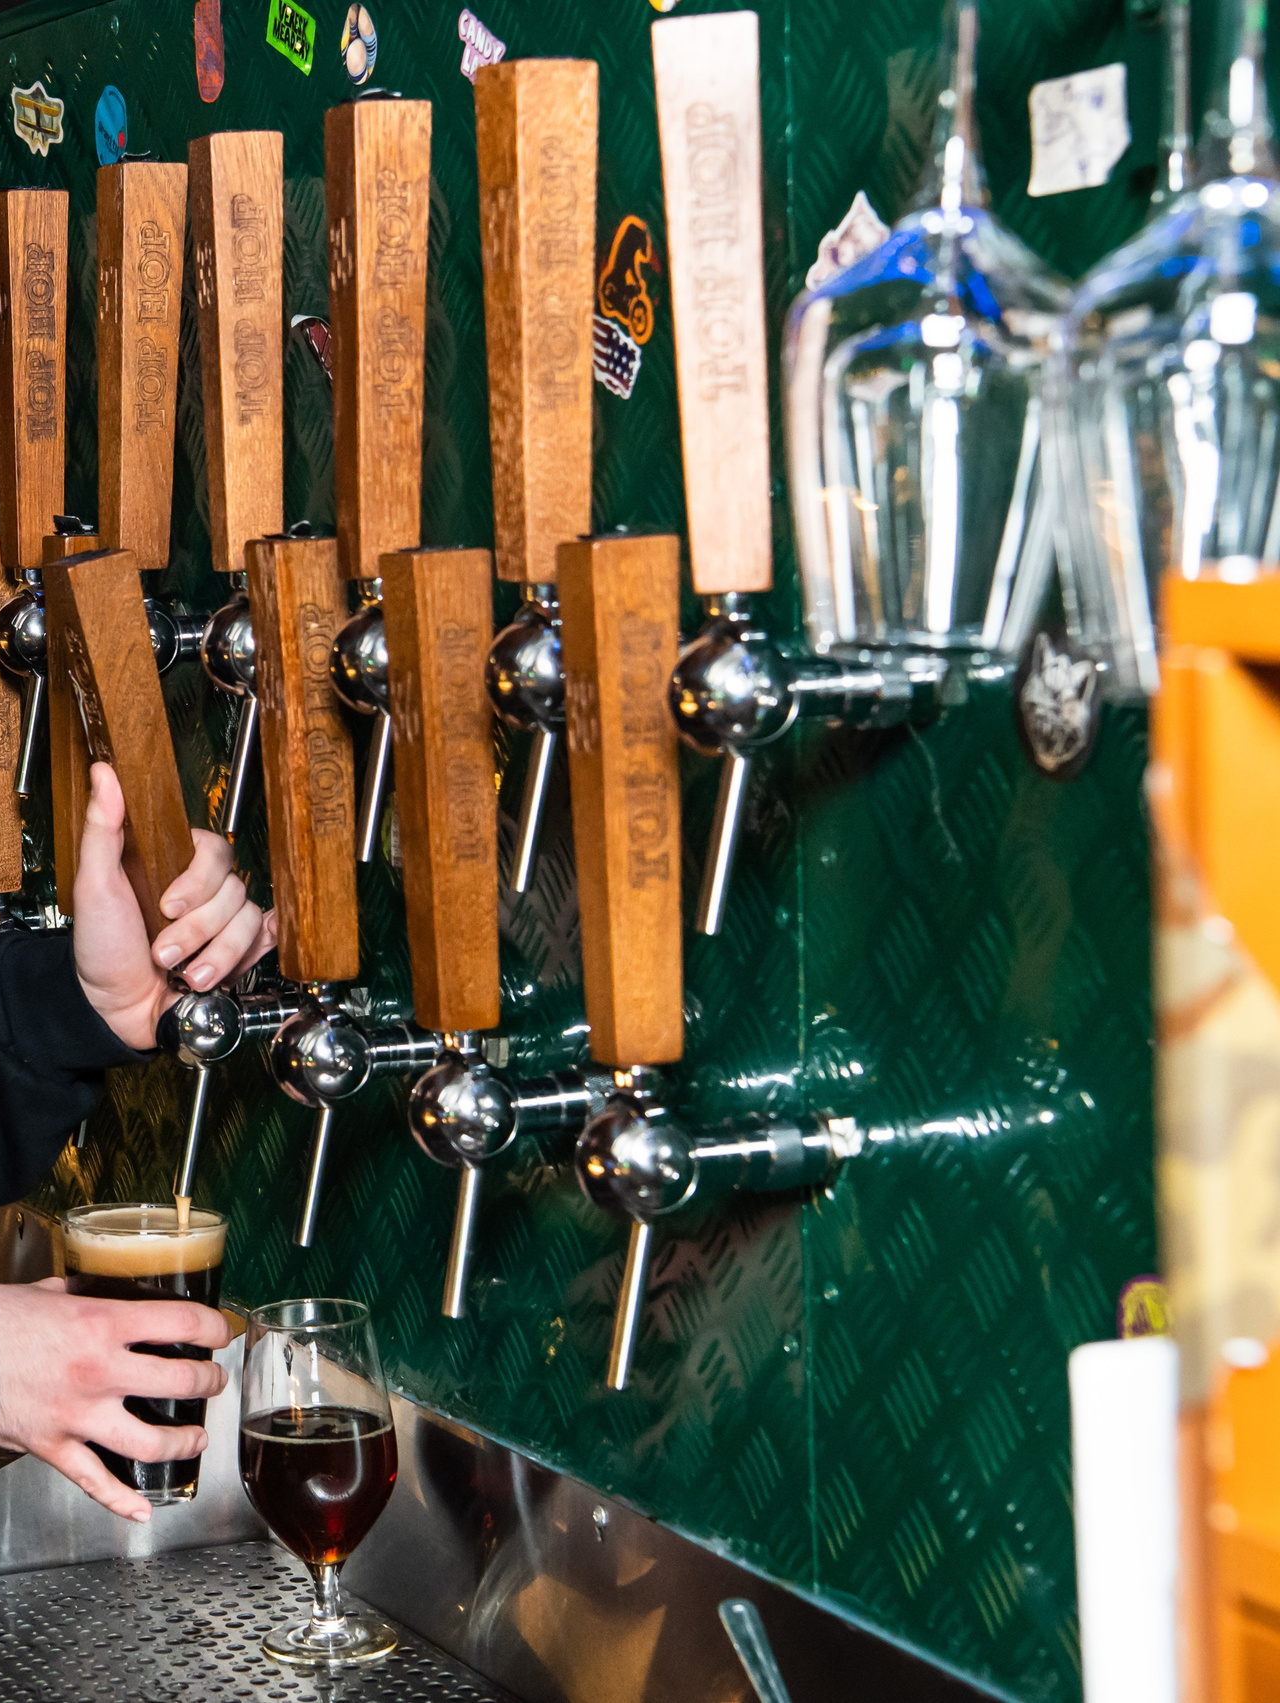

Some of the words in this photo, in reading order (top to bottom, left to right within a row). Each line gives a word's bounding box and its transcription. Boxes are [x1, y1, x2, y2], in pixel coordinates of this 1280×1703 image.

[460, 13, 503, 65] CANDY
[462, 48, 483, 76] LA
[375, 168, 412, 290] HOP
[539, 135, 580, 273] HOP
[685, 100, 738, 249] HOP
[25, 242, 56, 342] HOP
[137, 220, 171, 326] HOP
[232, 193, 267, 307] HOP
[134, 336, 168, 434] TOP
[235, 319, 272, 426] TOP
[375, 307, 411, 420] TOP
[538, 285, 580, 413] TOP
[695, 267, 749, 403] TOP
[27, 350, 57, 443] TOP
[299, 602, 335, 716] HOP
[437, 619, 479, 743] HOP
[620, 611, 666, 751] HOP
[307, 728, 348, 836] TOP
[446, 754, 489, 866] TOP
[625, 760, 672, 891] TOP
